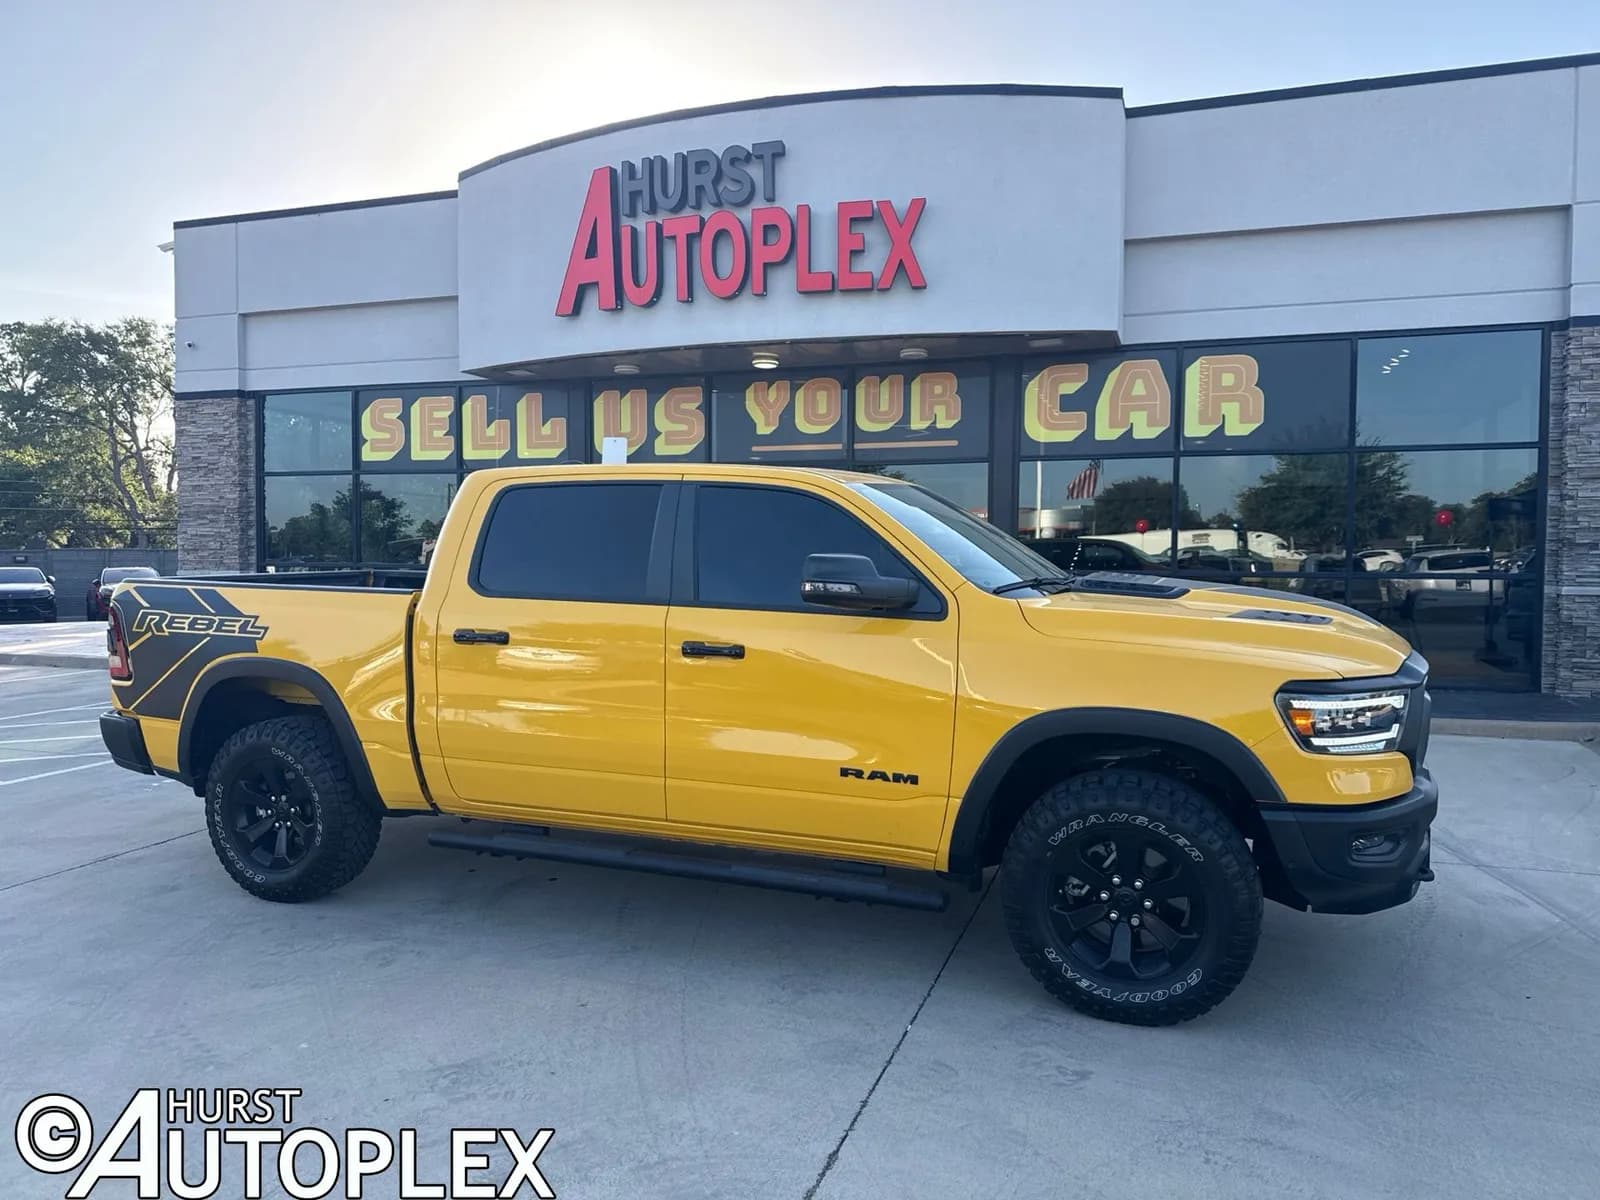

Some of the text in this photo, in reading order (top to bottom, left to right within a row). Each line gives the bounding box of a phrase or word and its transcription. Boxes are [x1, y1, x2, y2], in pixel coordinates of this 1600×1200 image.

[621, 140, 786, 217] HURST
[555, 166, 928, 317] AUTOPLEX
[361, 354, 1265, 461] SELL US YOUR CAR
[132, 608, 269, 640] REBEL
[839, 767, 919, 786] RAM
[1047, 810, 1204, 864] WRANGLER
[1043, 946, 1204, 1003] GOODYEAR
